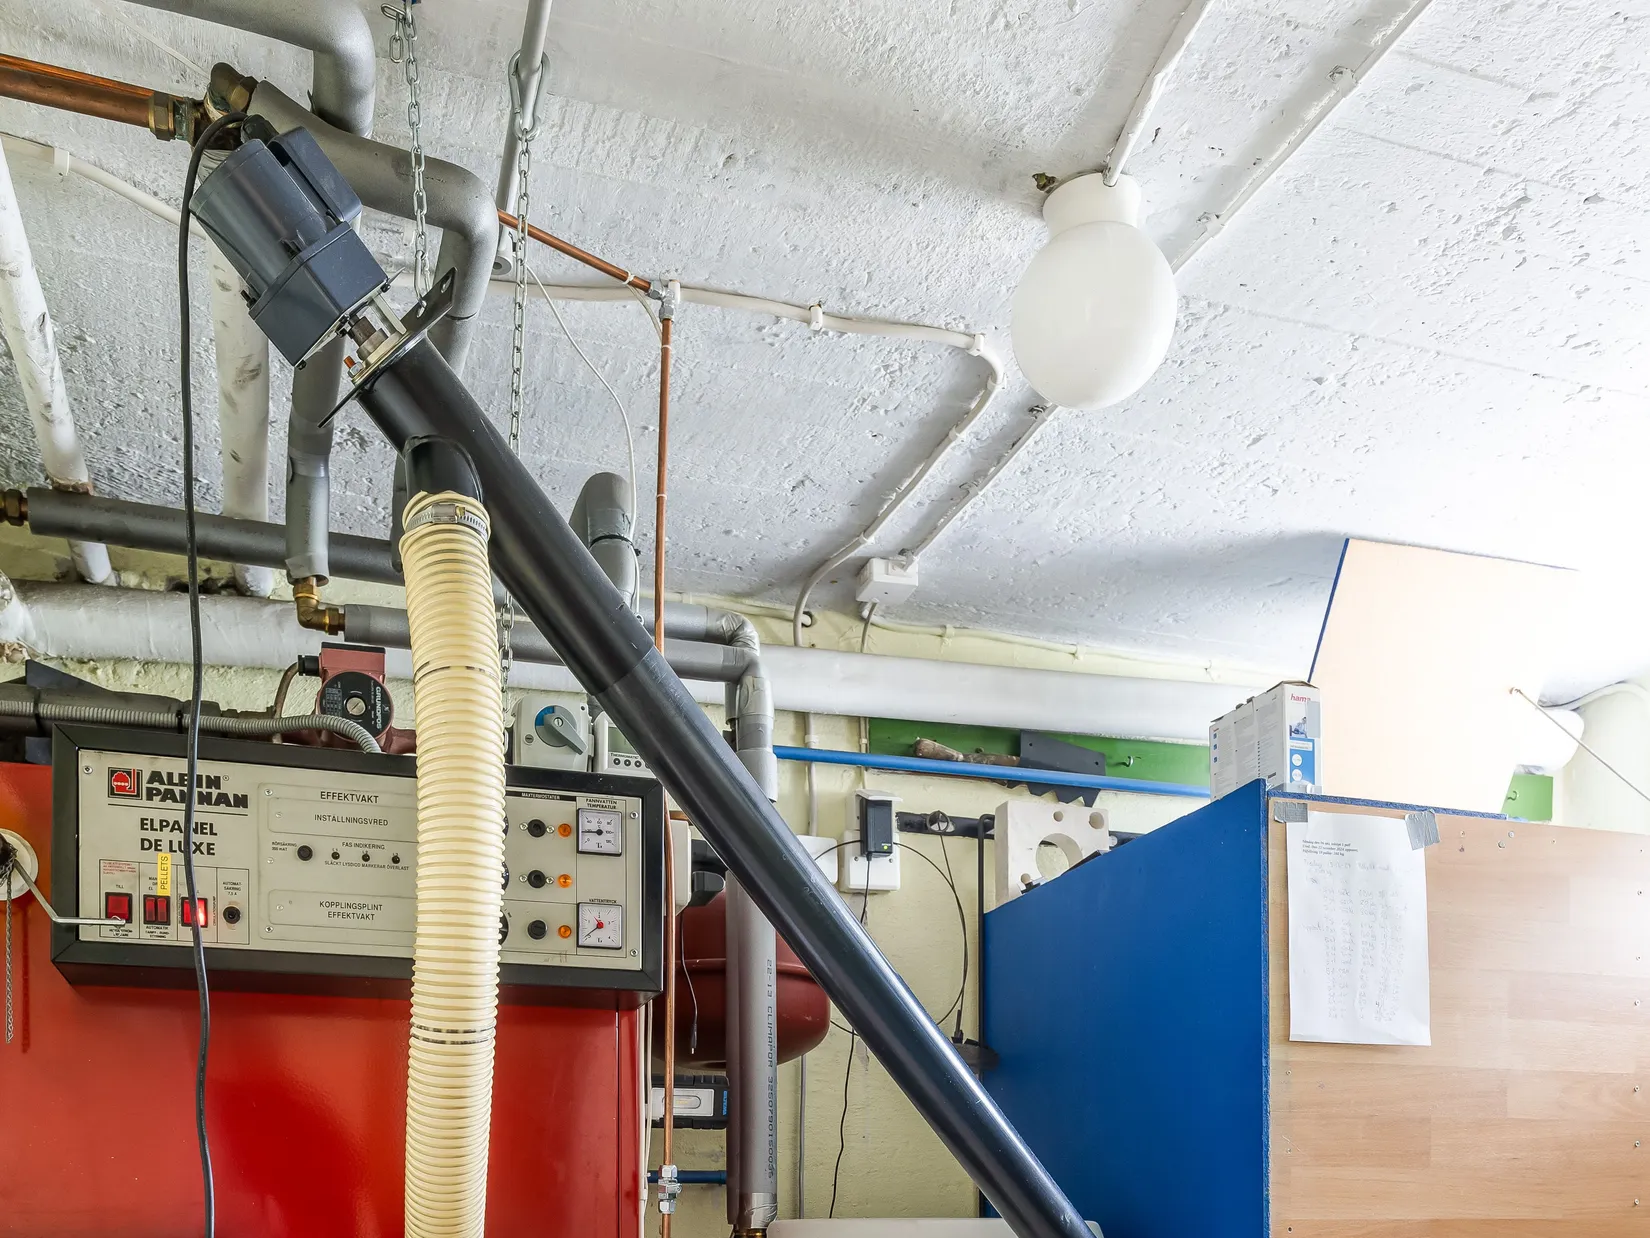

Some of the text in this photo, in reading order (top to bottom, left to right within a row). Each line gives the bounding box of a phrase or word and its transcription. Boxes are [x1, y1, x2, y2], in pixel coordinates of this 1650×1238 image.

[320, 791, 379, 804] EFFEKTVAKT
[140, 838, 163, 852] DE
[353, 842, 385, 850] INDIKERING
[160, 856, 169, 890] PELLETS
[319, 901, 383, 911] KOPPLINGSPLINT
[327, 911, 375, 921] EFFEKTVAKT
